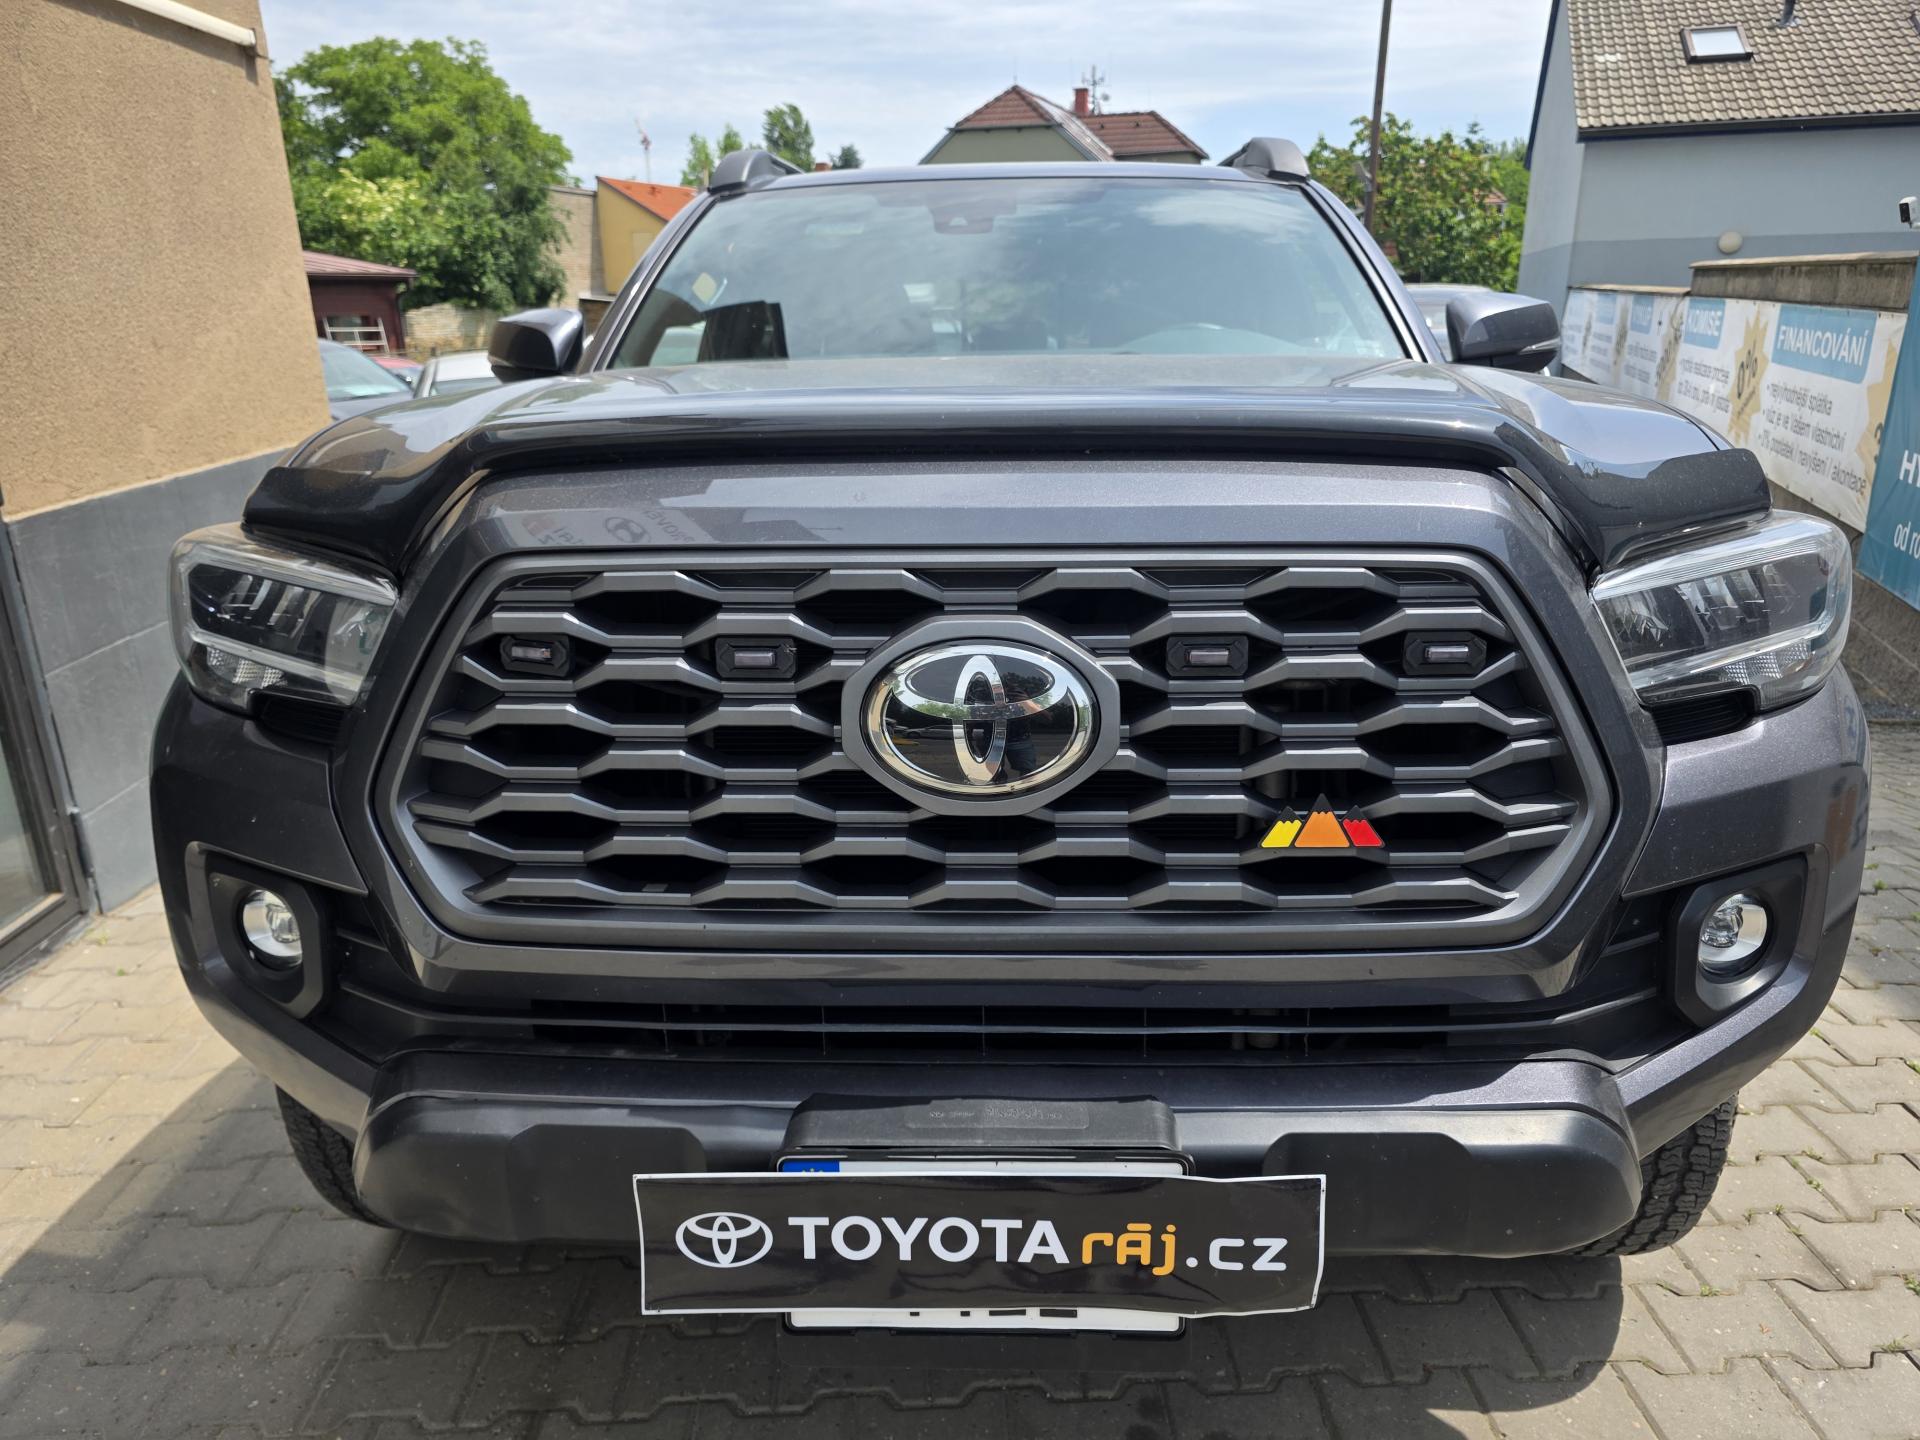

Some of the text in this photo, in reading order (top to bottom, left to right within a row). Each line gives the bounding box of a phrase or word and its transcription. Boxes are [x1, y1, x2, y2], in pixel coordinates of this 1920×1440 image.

[1777, 325, 1869, 366] FINANCOVÁNÍ
[1894, 521, 1911, 552] od
[788, 1216, 1070, 1264] TOYOTA
